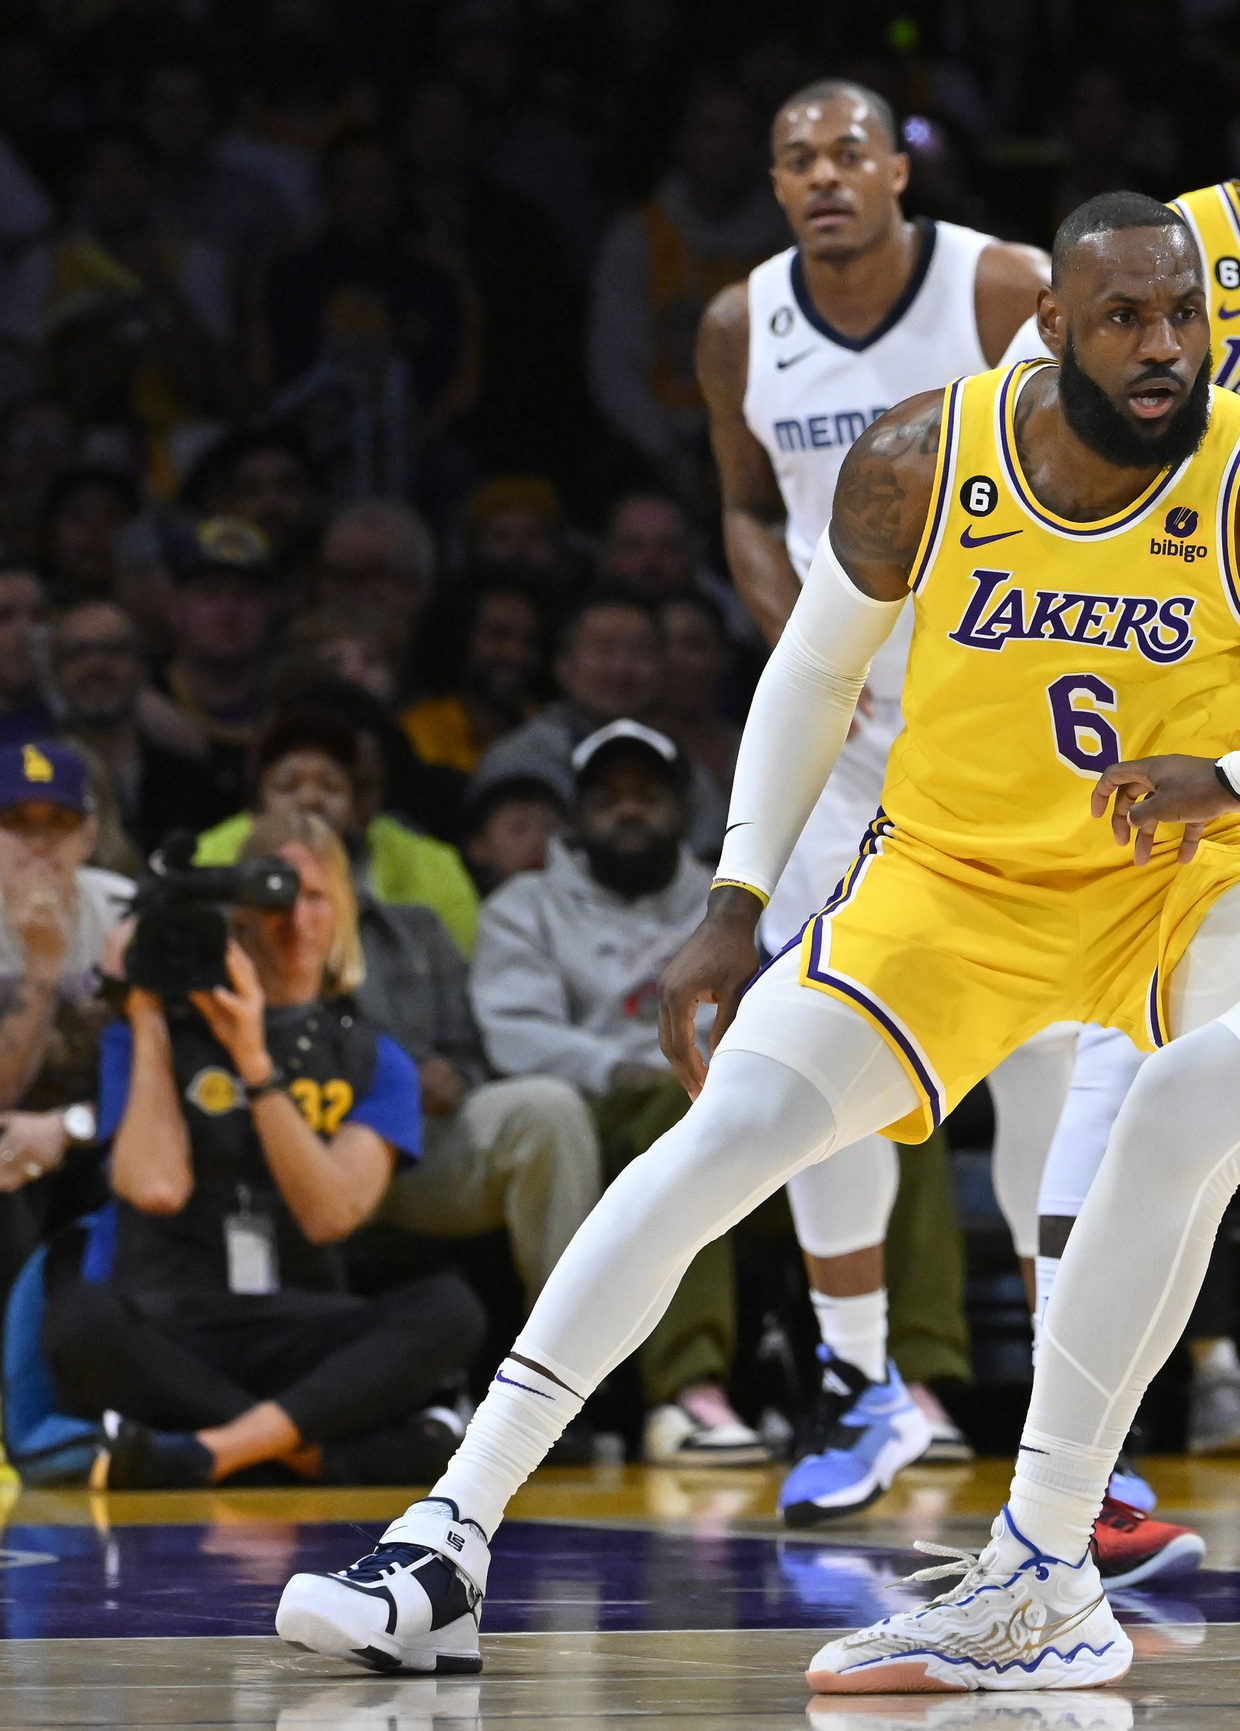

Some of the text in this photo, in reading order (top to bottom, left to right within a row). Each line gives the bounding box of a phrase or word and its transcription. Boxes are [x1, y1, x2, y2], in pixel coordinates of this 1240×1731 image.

[1217, 258, 1240, 289] 6
[968, 480, 991, 513] 6
[1149, 538, 1208, 563] bibigo
[948, 566, 1199, 666] LAKERS
[1044, 671, 1122, 781] 6
